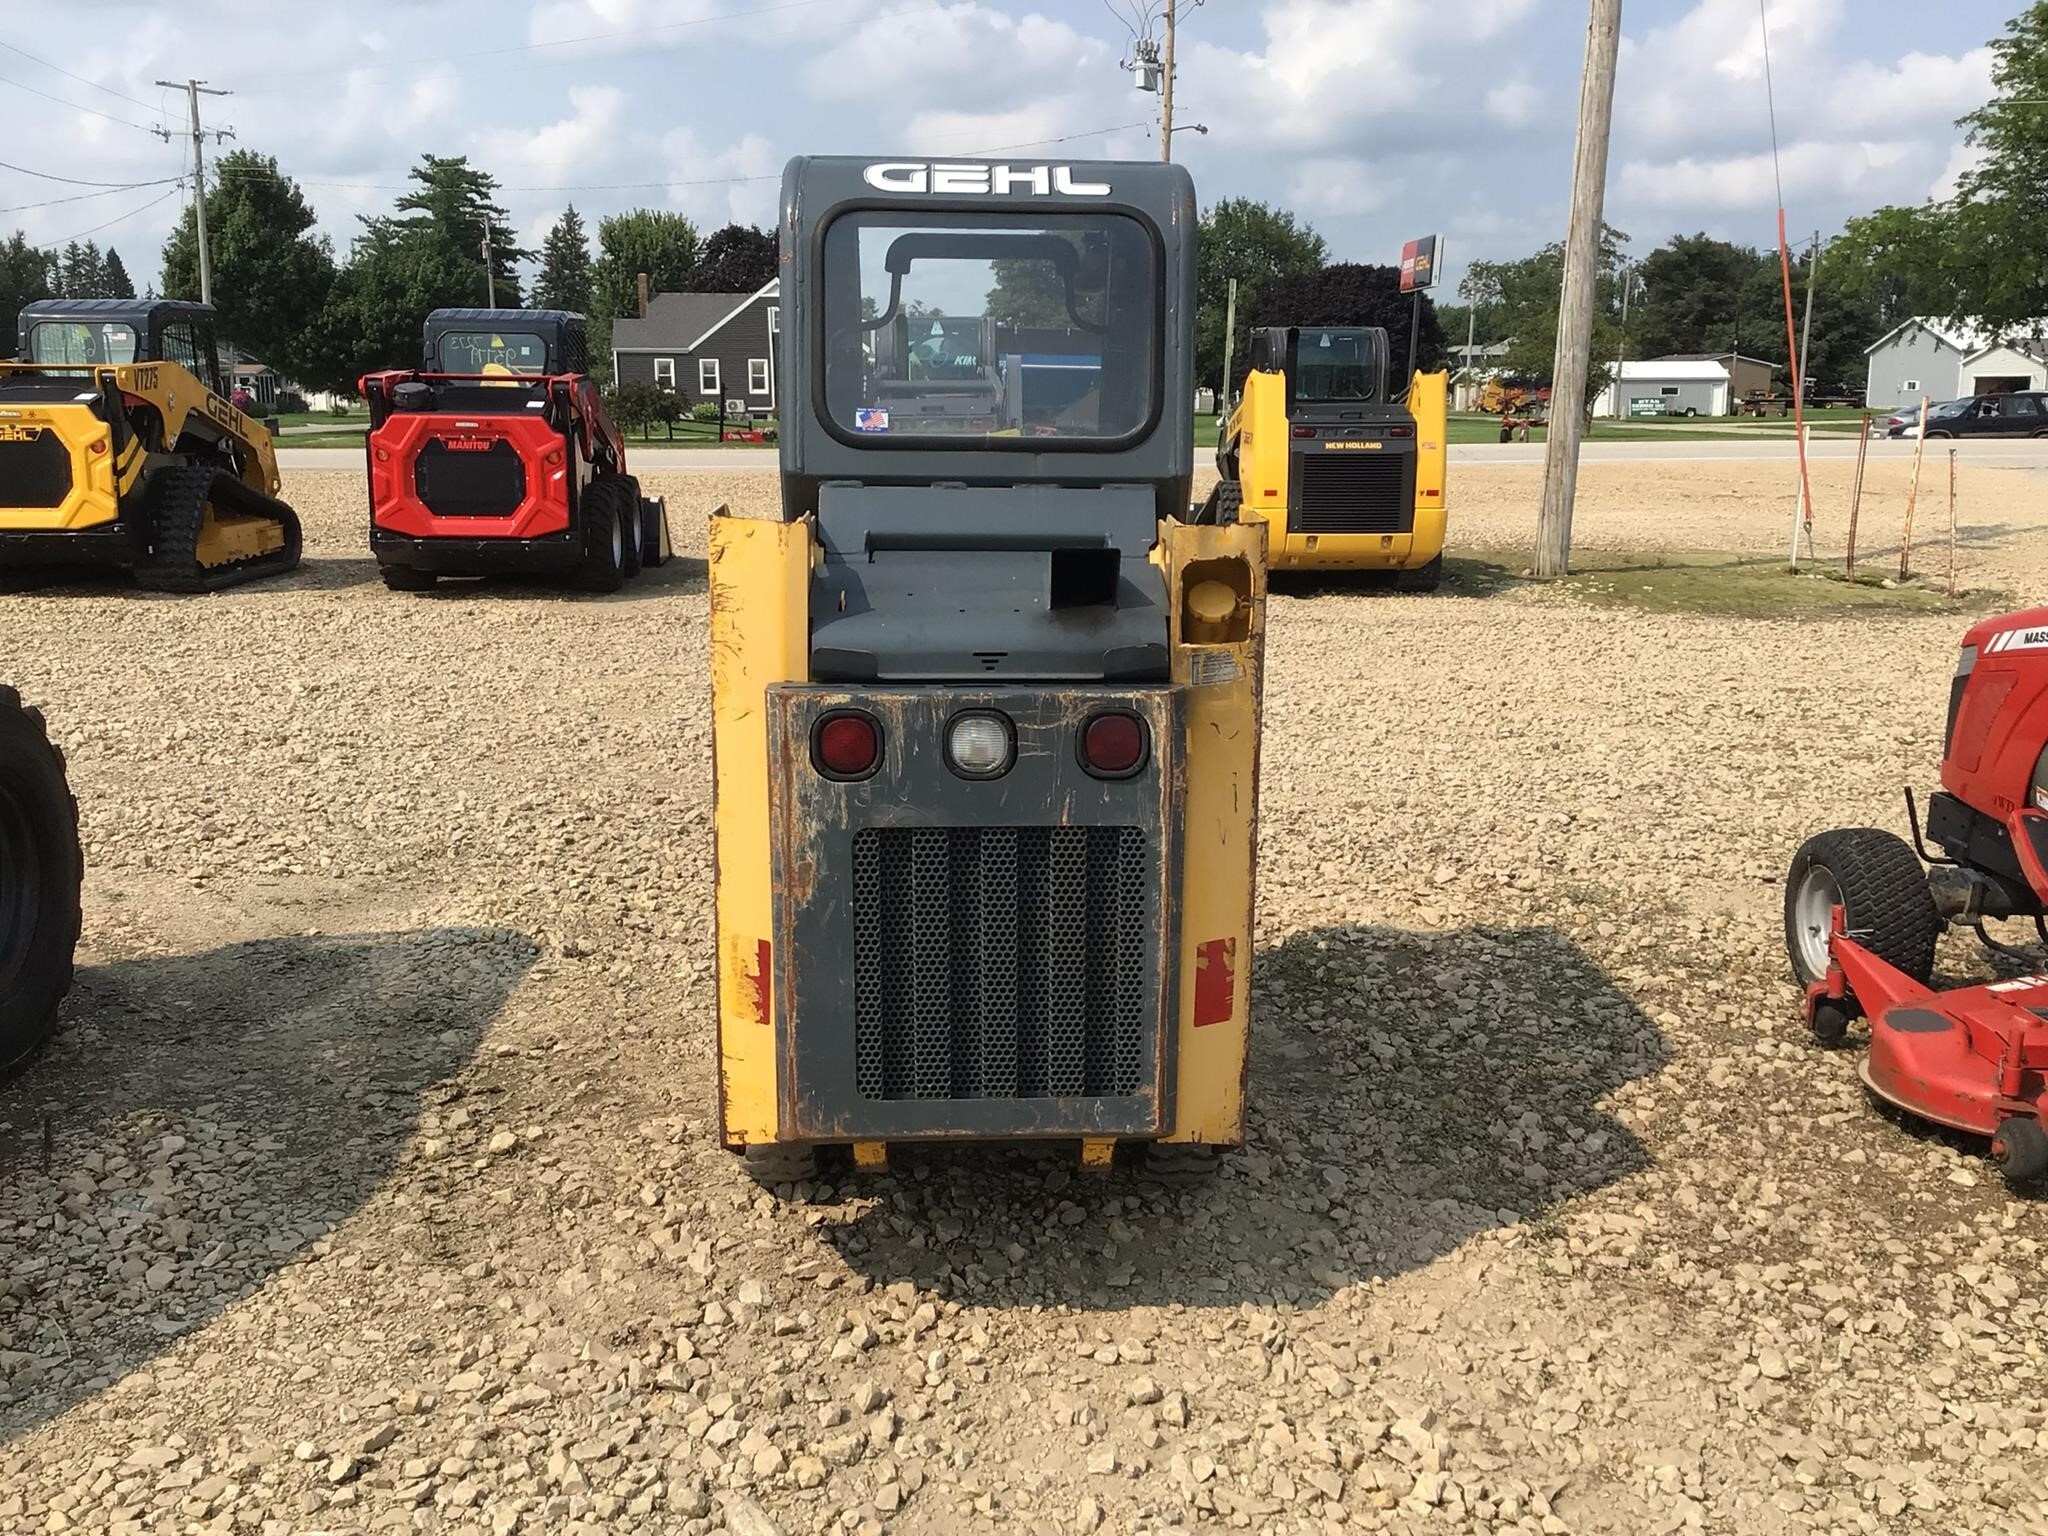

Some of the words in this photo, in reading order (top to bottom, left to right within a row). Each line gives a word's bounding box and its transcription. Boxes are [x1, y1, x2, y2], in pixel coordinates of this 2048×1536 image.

[863, 163, 1112, 196] GEHL
[134, 366, 159, 391] VT275
[206, 392, 249, 440] GEHL
[448, 440, 490, 449] MANITOU
